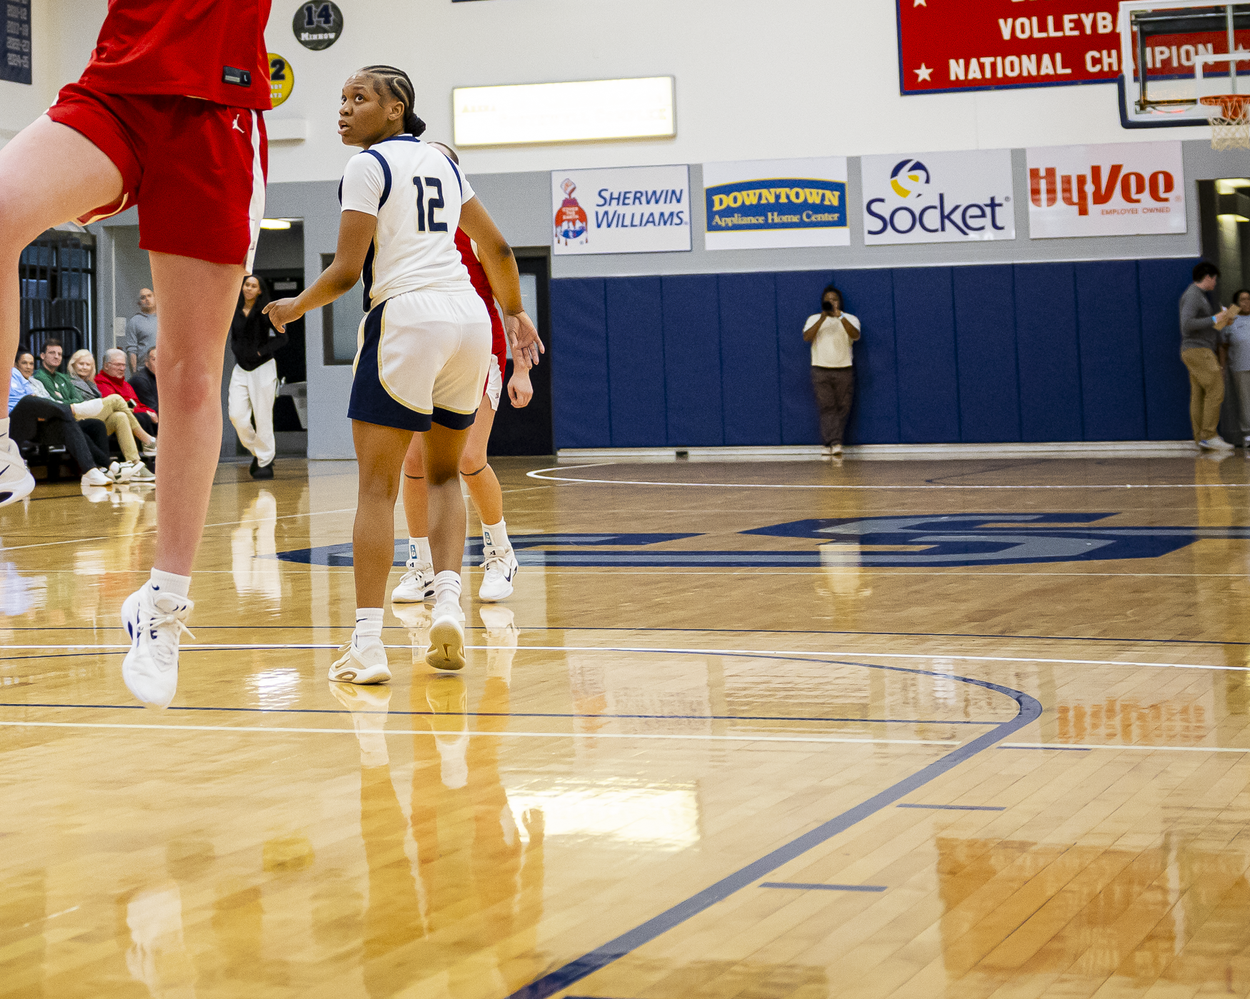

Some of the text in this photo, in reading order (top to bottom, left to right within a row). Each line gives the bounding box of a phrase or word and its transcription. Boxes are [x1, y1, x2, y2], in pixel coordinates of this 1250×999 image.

[304, 2, 333, 28] 14
[998, 15, 1123, 40] VOLLEYB
[948, 42, 1214, 81] NATIONAL CHPION
[412, 176, 448, 233] 12
[596, 188, 684, 207] SHERWIN
[712, 187, 840, 211] DOWNTOWN
[595, 210, 685, 228] WILLIAMS
[712, 210, 840, 227] Appliance Home Center
[866, 193, 1005, 236] Socket
[1101, 206, 1171, 216] EMPLOYEE OWNED
